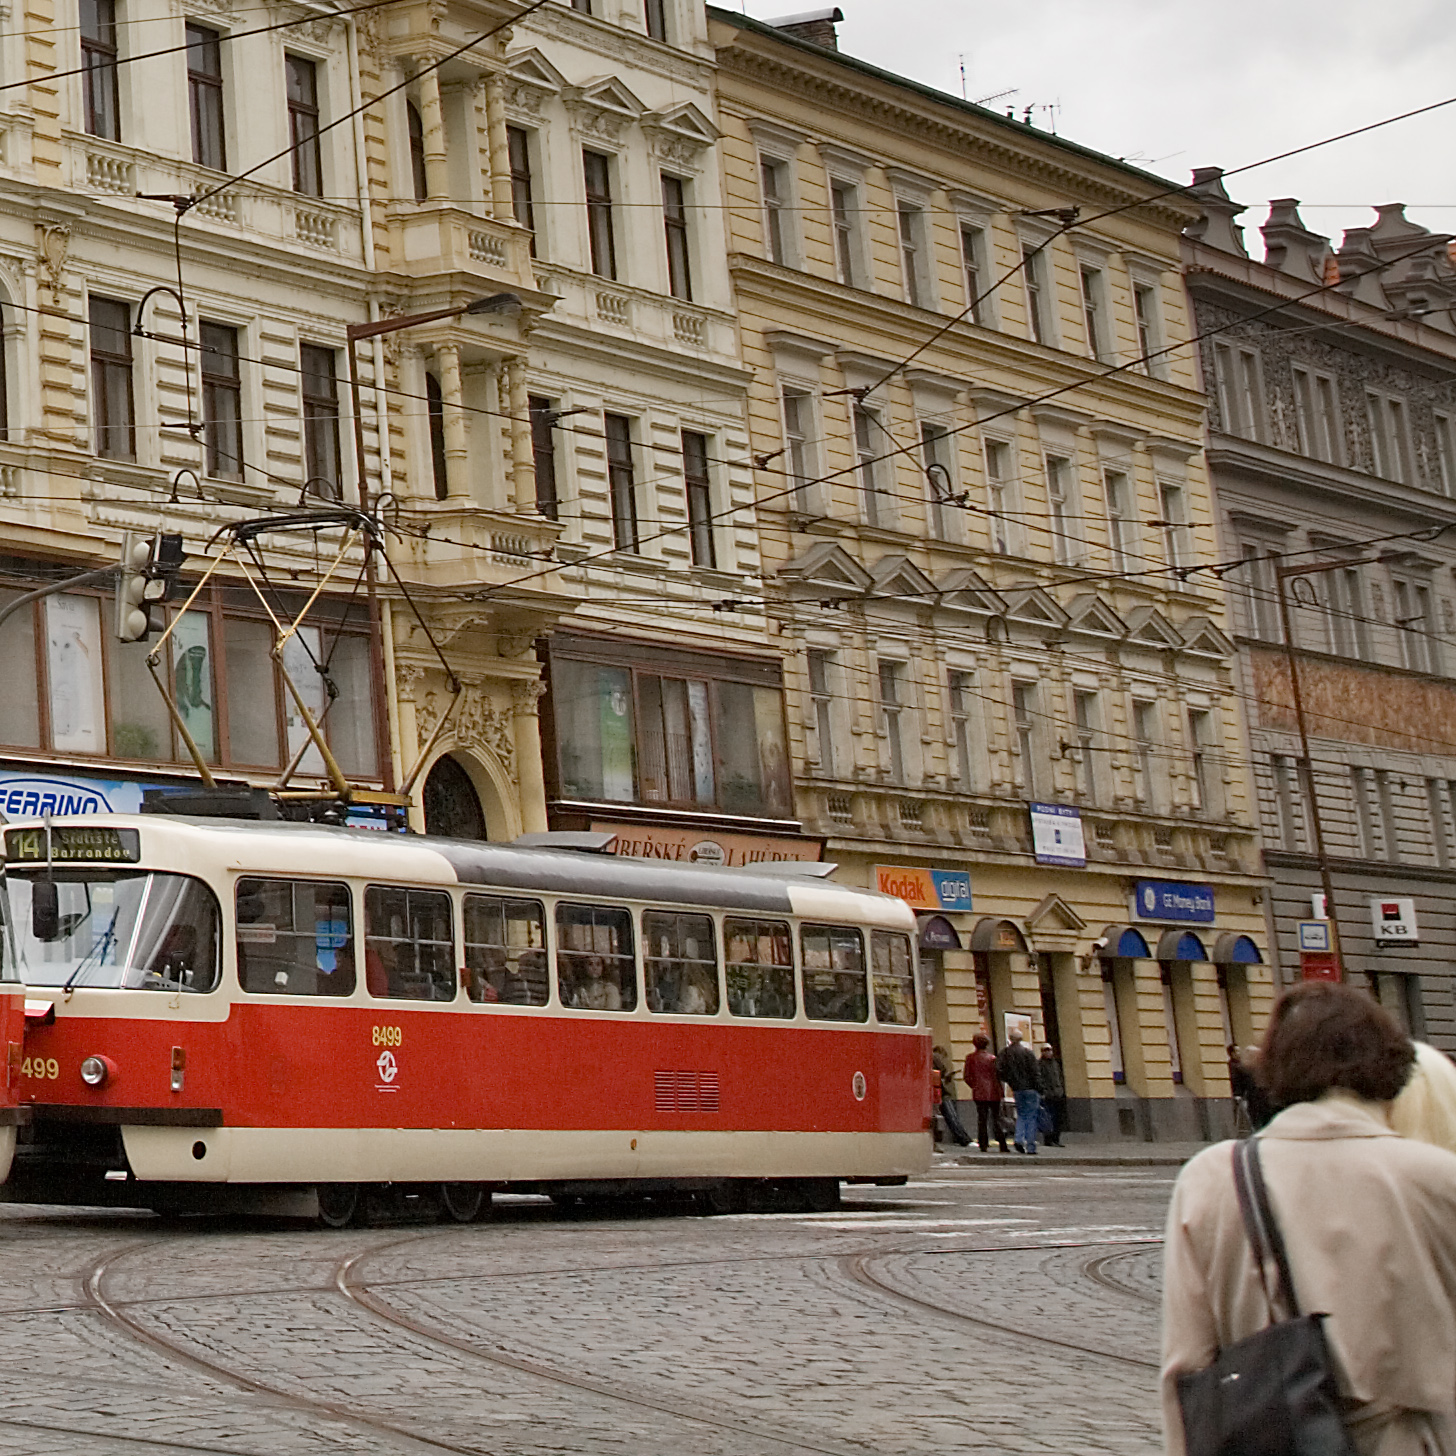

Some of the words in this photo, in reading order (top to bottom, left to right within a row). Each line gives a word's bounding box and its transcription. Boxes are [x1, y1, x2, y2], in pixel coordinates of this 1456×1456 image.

[12, 831, 40, 859] 14
[879, 873, 926, 901] Kodak
[1380, 925, 1408, 935] KB
[372, 1025, 402, 1047] 8499
[21, 1056, 60, 1080] 499
